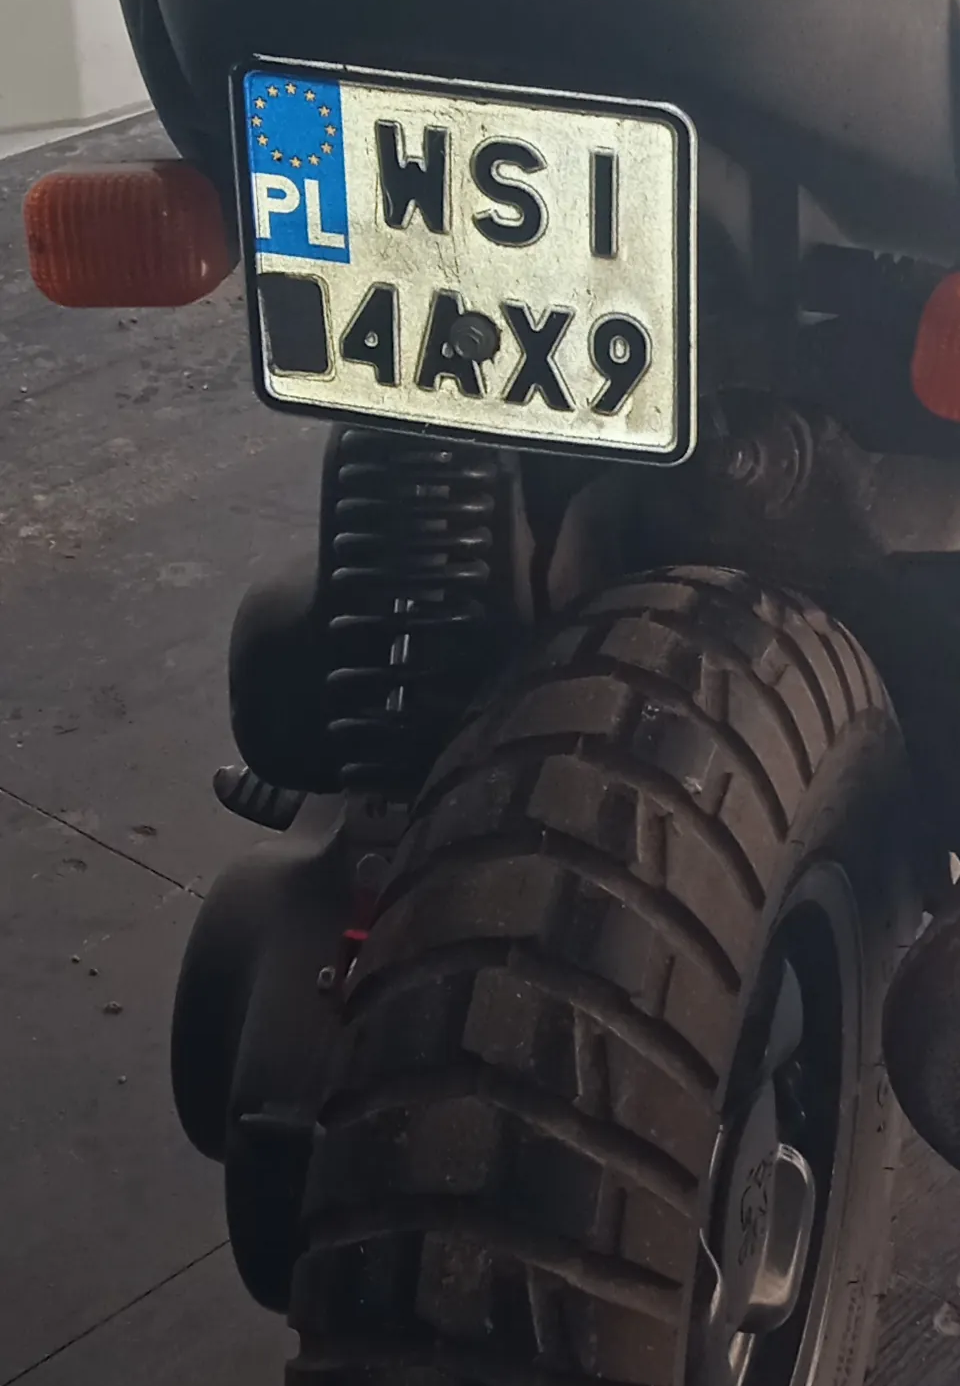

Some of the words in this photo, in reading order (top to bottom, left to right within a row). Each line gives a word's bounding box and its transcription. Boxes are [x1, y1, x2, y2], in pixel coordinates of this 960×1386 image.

[254, 172, 346, 249] PL
[375, 118, 618, 258] WSI
[340, 282, 652, 415] 4AX9
